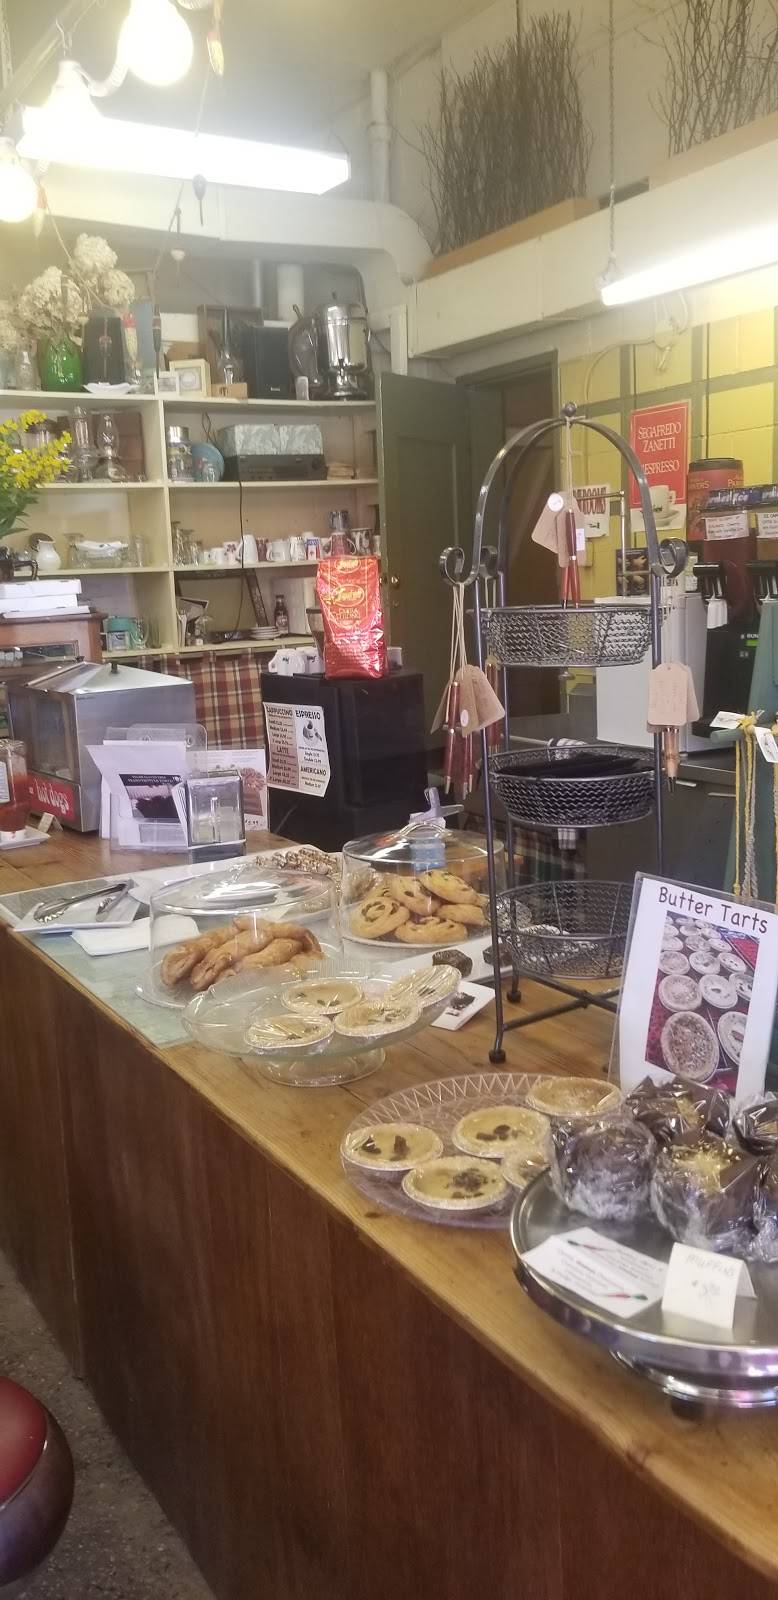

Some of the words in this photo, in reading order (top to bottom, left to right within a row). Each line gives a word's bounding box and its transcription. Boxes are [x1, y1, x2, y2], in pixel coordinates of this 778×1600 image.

[638, 421, 682, 440] SEGAFREDO
[642, 437, 676, 453] ZANETTI
[295, 709, 321, 720] ESPRESSO
[300, 766, 327, 776] AMERICANO
[34, 777, 51, 804] hot
[49, 783, 69, 815] dogs
[658, 886, 713, 917] Butter
[720, 903, 768, 934] Tarts
